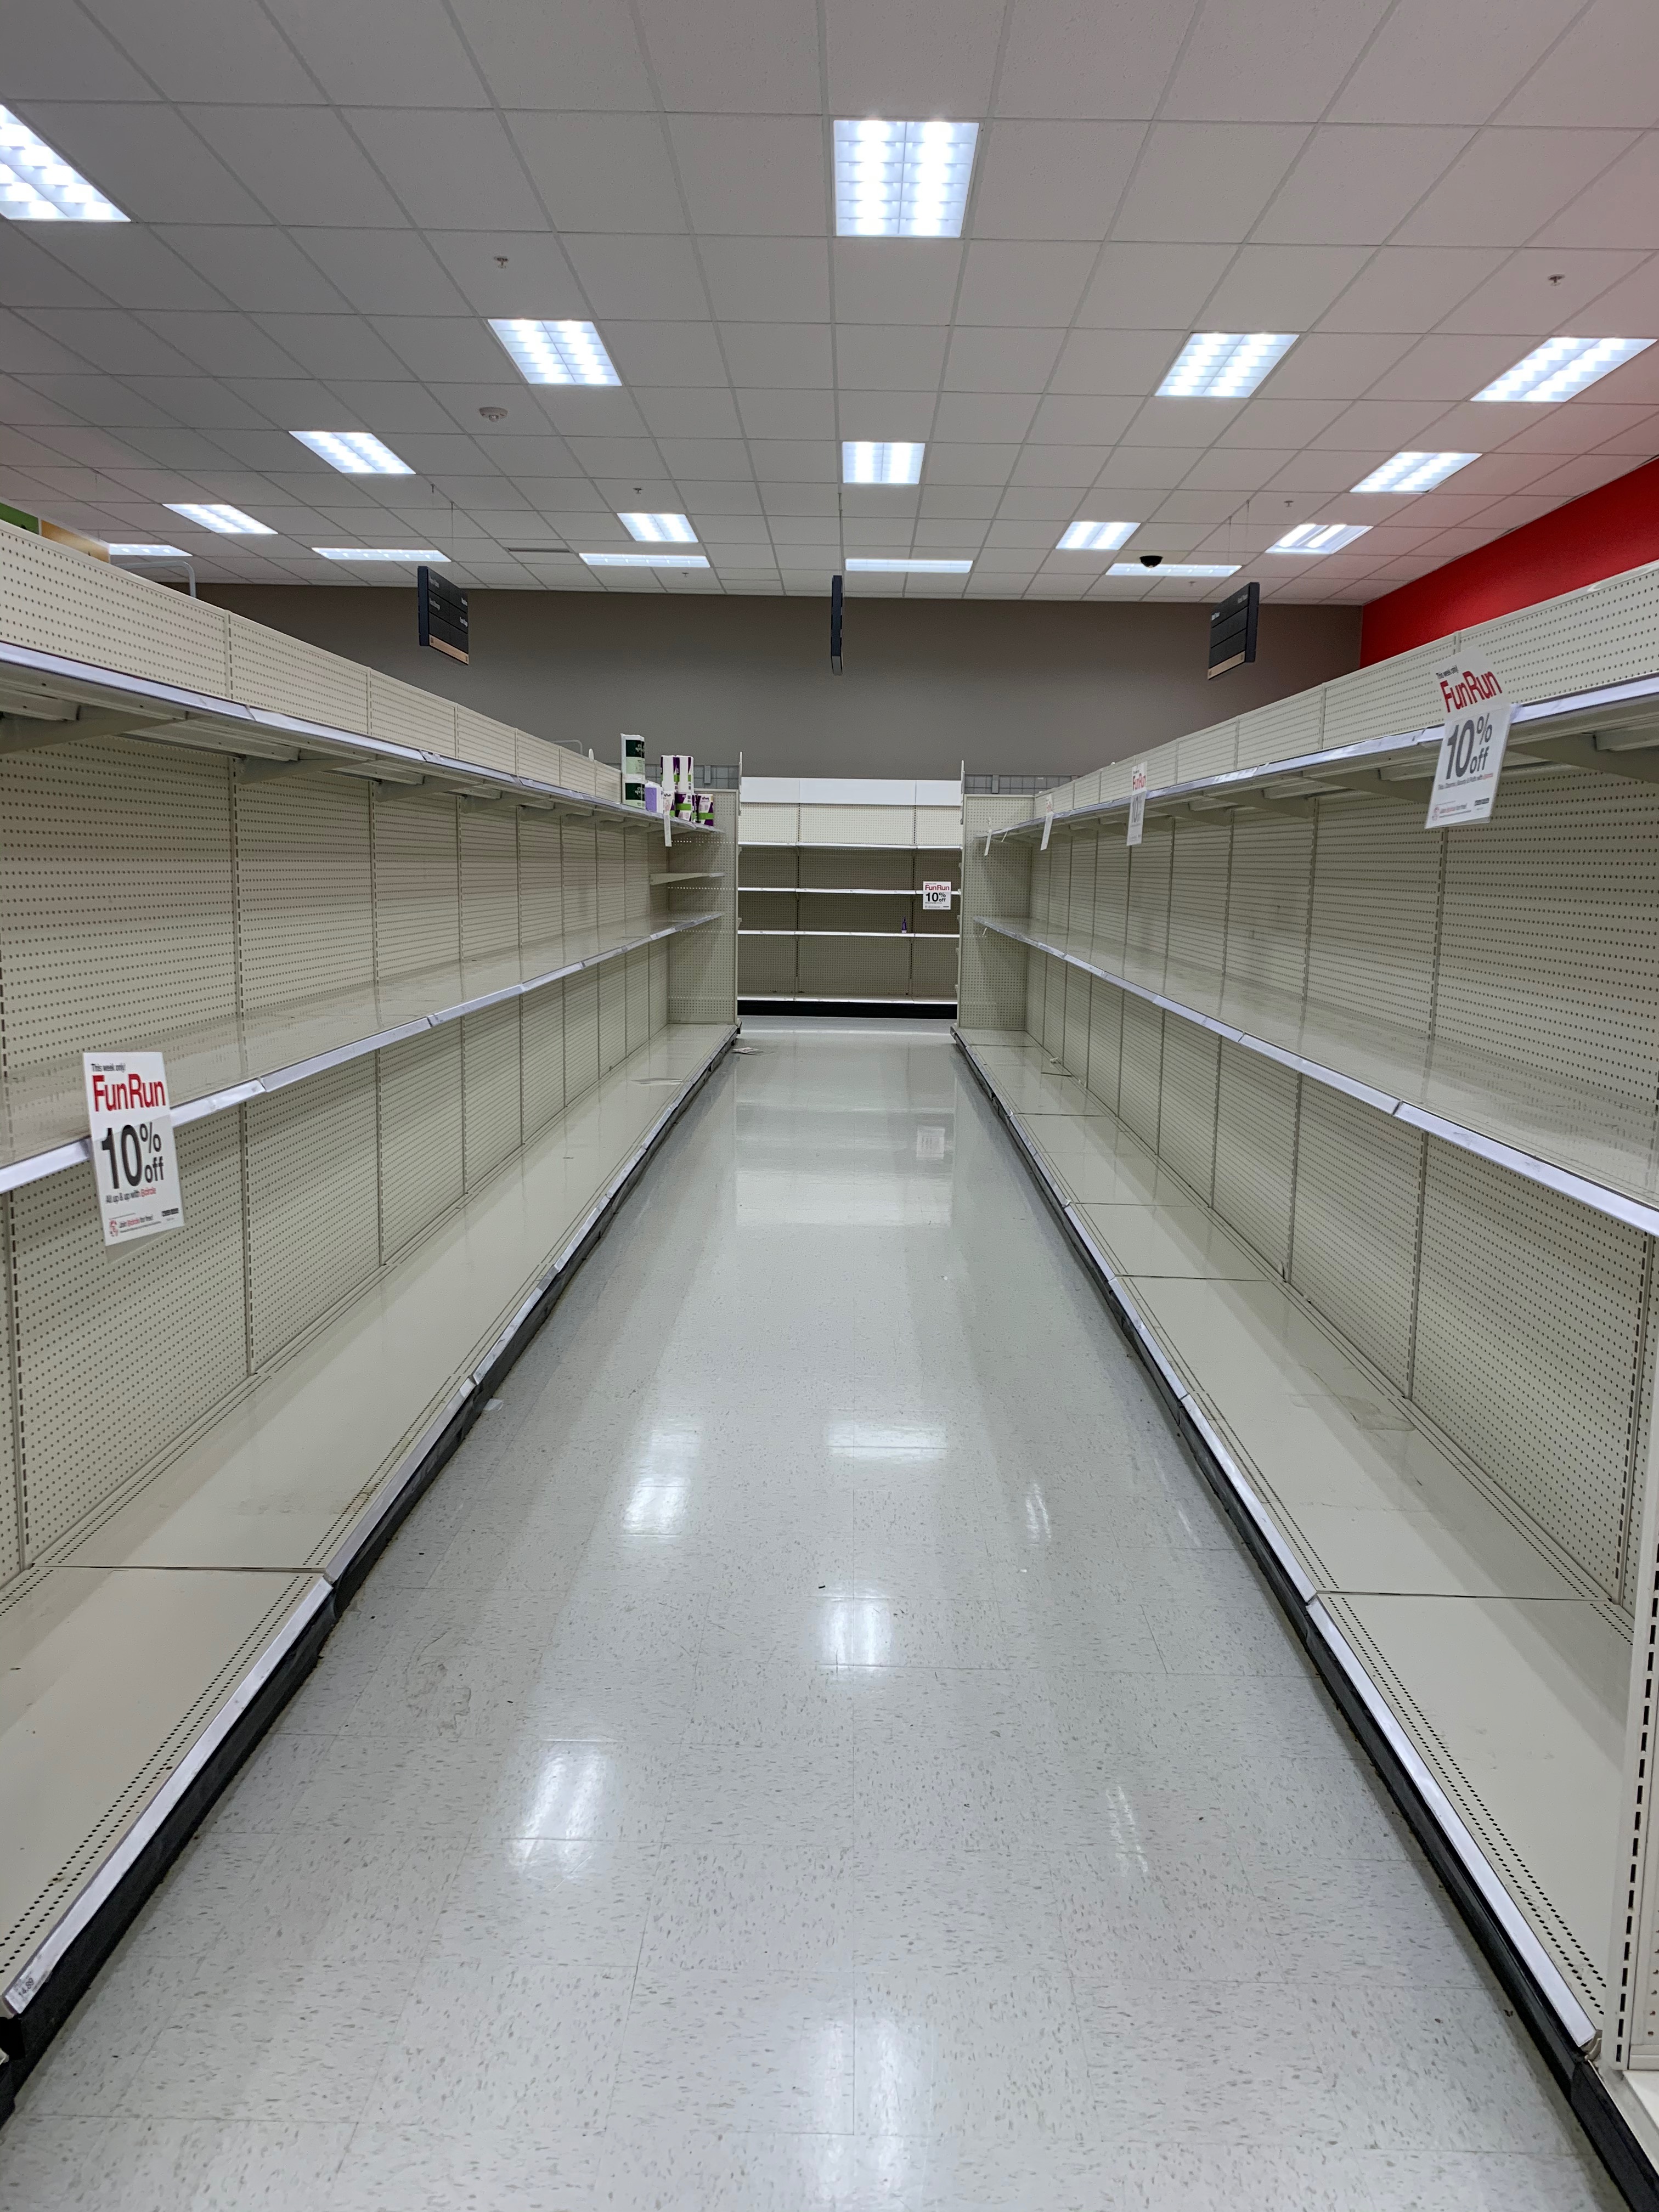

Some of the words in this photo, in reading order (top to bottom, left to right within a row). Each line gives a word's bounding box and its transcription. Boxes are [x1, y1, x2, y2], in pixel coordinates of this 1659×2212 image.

[1440, 670, 1503, 713] FunRun
[1470, 746, 1489, 774] off
[91, 1063, 102, 1072] This
[103, 1063, 114, 1071] week
[92, 1073, 166, 1112] FunRun
[144, 1156, 165, 1183] off
